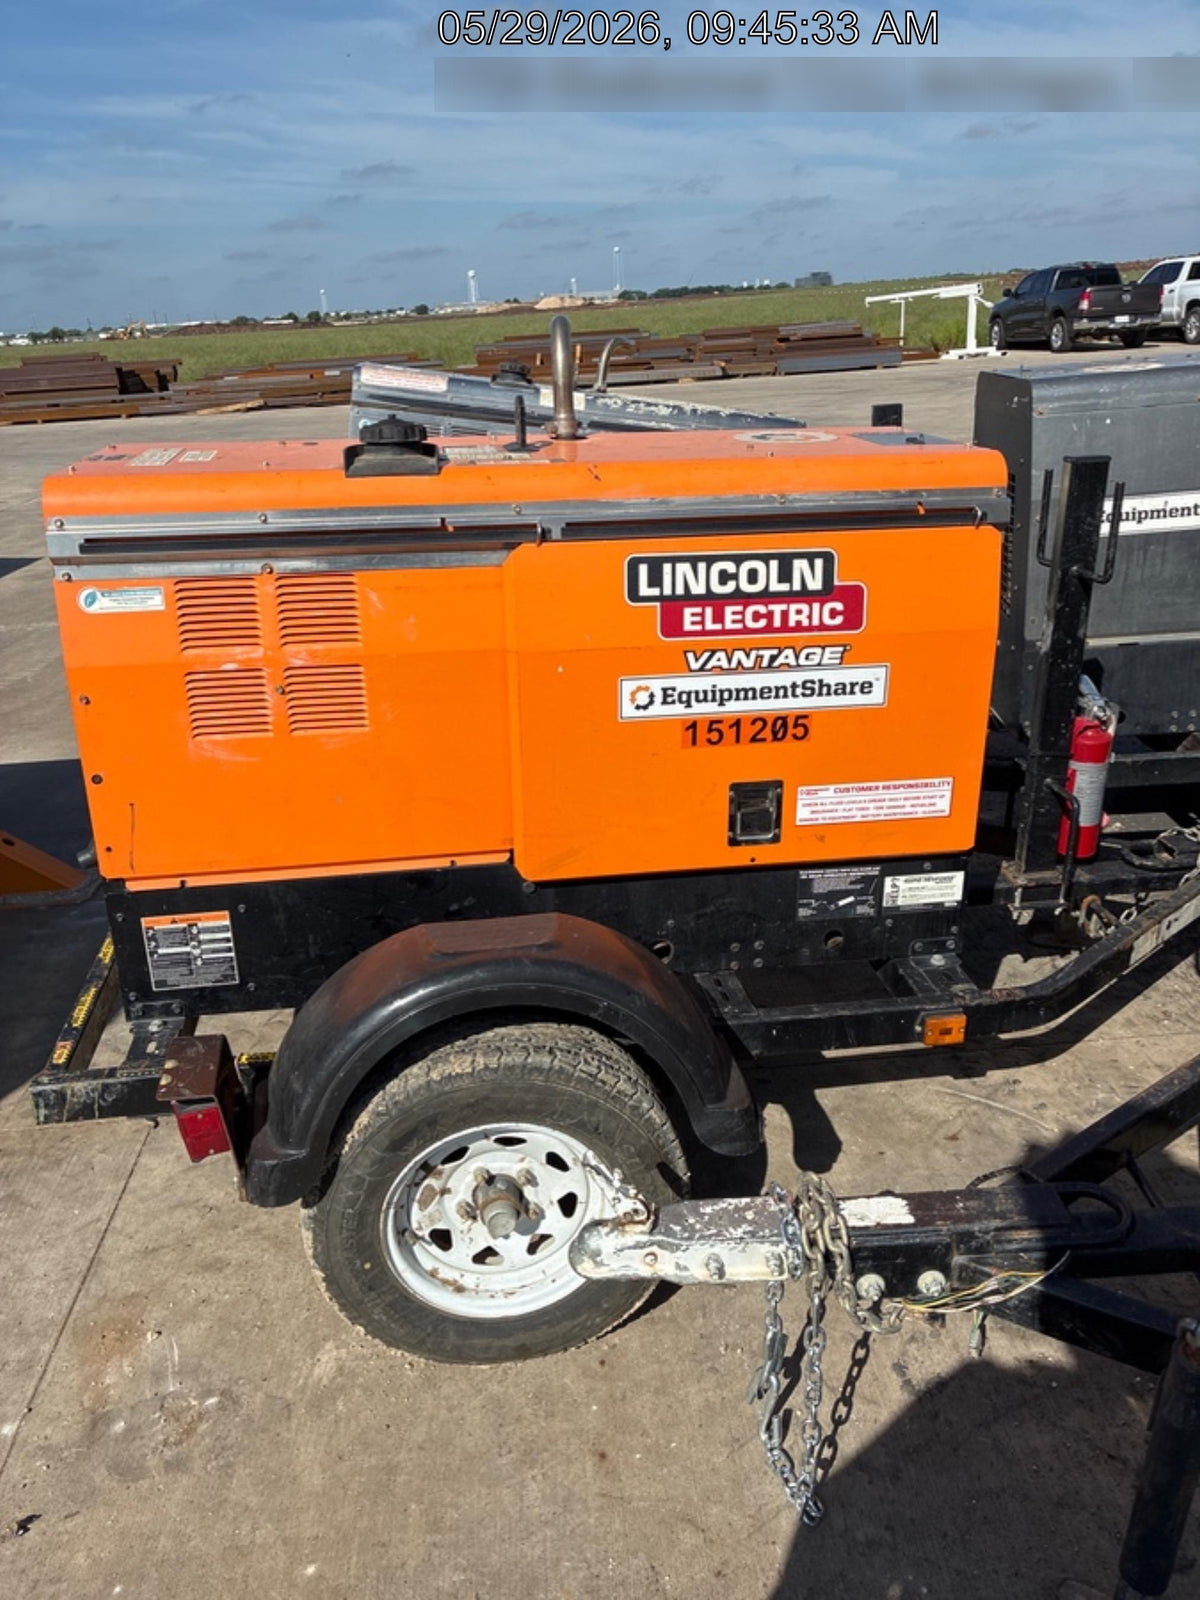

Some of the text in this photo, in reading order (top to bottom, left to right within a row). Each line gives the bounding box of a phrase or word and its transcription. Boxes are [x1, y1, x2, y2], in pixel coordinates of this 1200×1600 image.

[637, 557, 824, 597] LINCOLN
[682, 601, 845, 632] ELECTRIC
[684, 646, 847, 671] VANTAGE
[660, 677, 874, 710] EquipmentShare
[684, 714, 810, 747] 151205
[833, 785, 882, 794] CUSTOMER
[881, 780, 951, 791] RESPONSIBILITY
